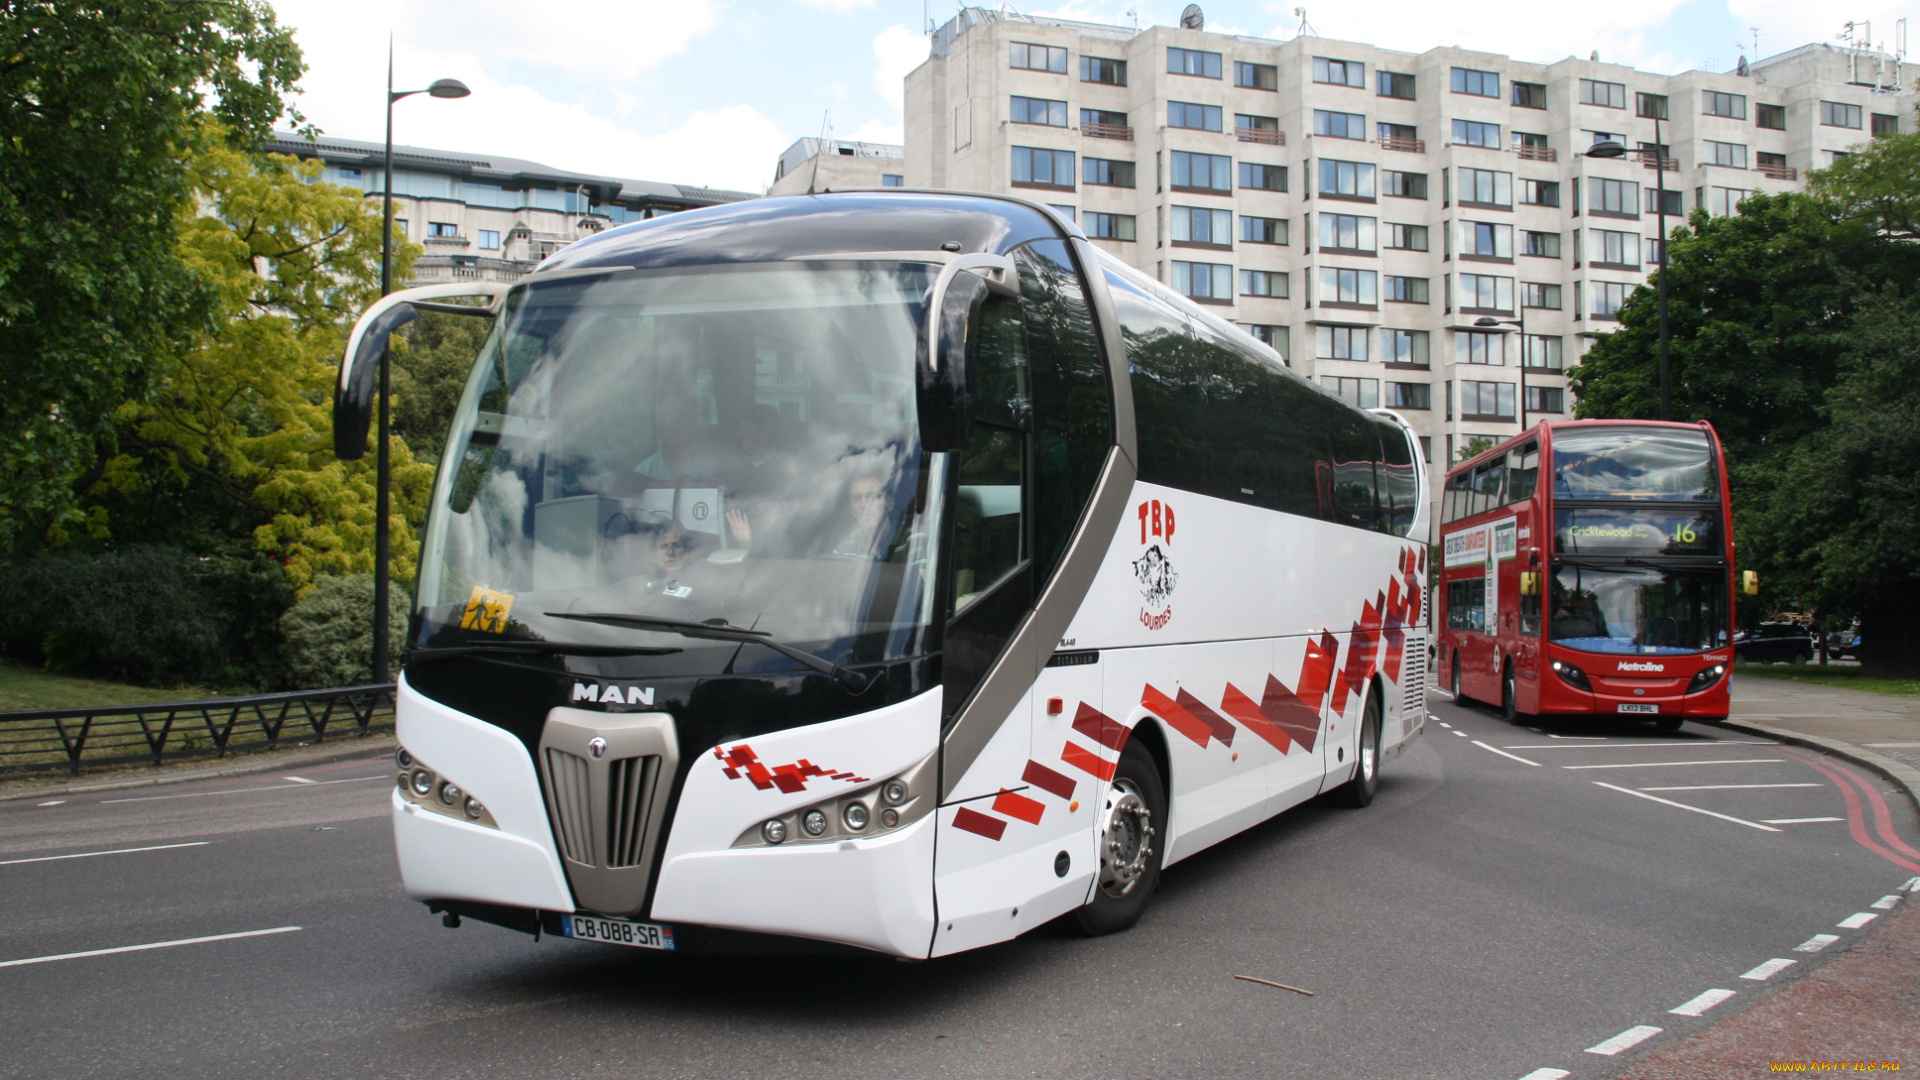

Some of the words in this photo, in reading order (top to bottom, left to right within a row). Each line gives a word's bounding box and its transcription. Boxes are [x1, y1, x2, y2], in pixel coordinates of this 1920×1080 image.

[1138, 499, 1175, 547] TBP
[1569, 525, 1632, 538] Cricklewood
[1676, 522, 1697, 543] 16
[1139, 604, 1171, 631] LOURDES
[1057, 654, 1093, 665] TITANIUM
[1617, 661, 1664, 672] Metroline
[572, 682, 655, 706] MAN
